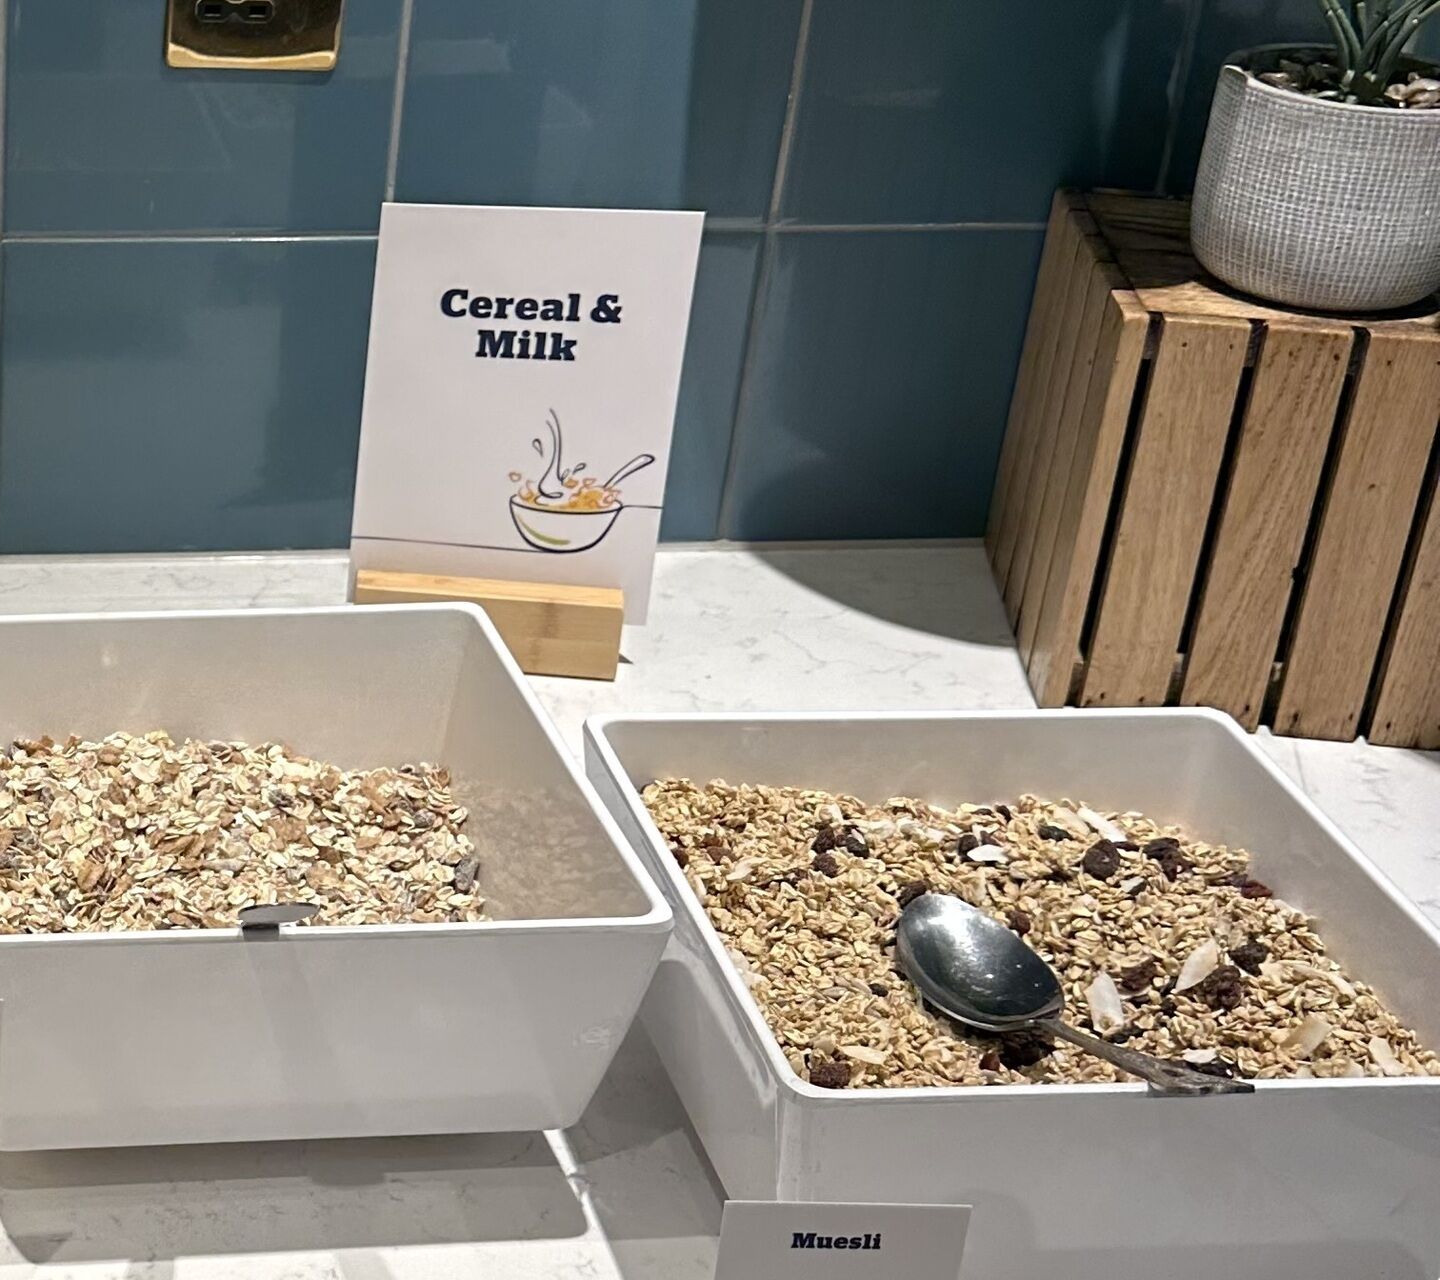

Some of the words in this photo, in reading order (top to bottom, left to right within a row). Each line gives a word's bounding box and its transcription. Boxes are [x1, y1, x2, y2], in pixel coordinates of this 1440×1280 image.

[441, 288, 580, 322] Cereal
[591, 293, 622, 324] &
[475, 329, 578, 361] Milk
[790, 1232, 882, 1250] Muesli
